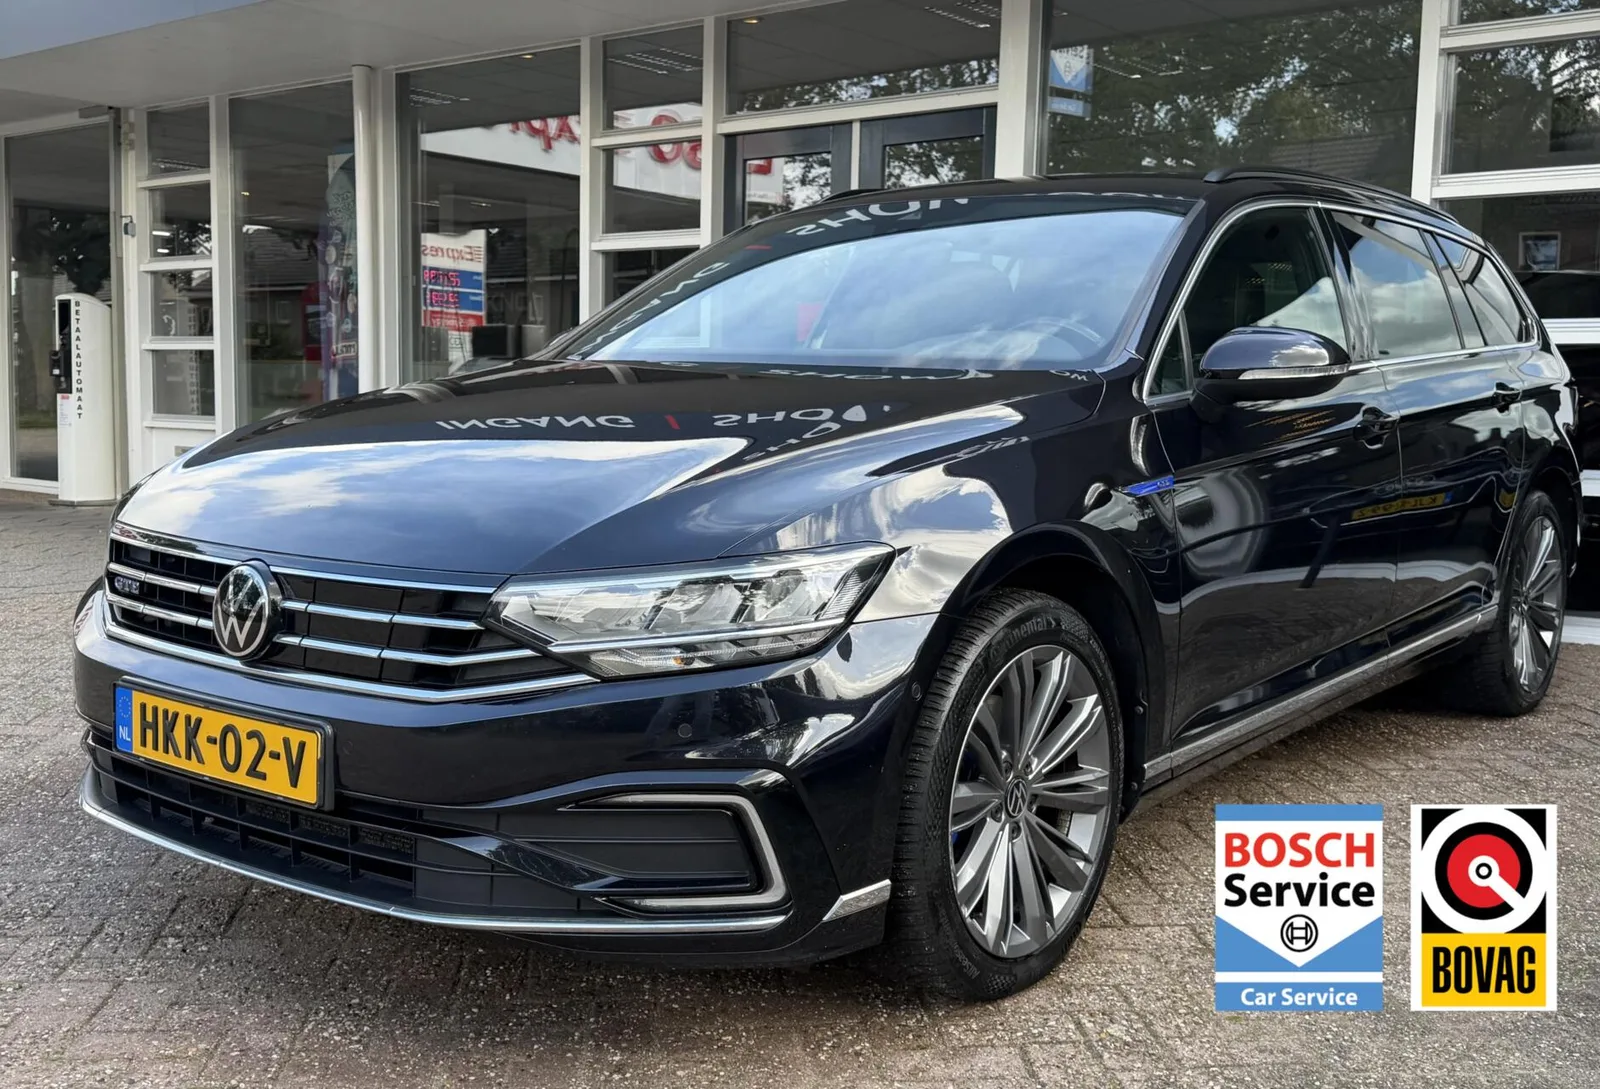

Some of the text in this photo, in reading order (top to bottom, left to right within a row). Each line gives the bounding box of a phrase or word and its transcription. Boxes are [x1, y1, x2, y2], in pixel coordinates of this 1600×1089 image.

[74, 300, 83, 419] BETAALAUTOMAAT
[114, 575, 140, 595] GTE
[119, 725, 131, 742] NL
[139, 701, 307, 788] HKK-02-V
